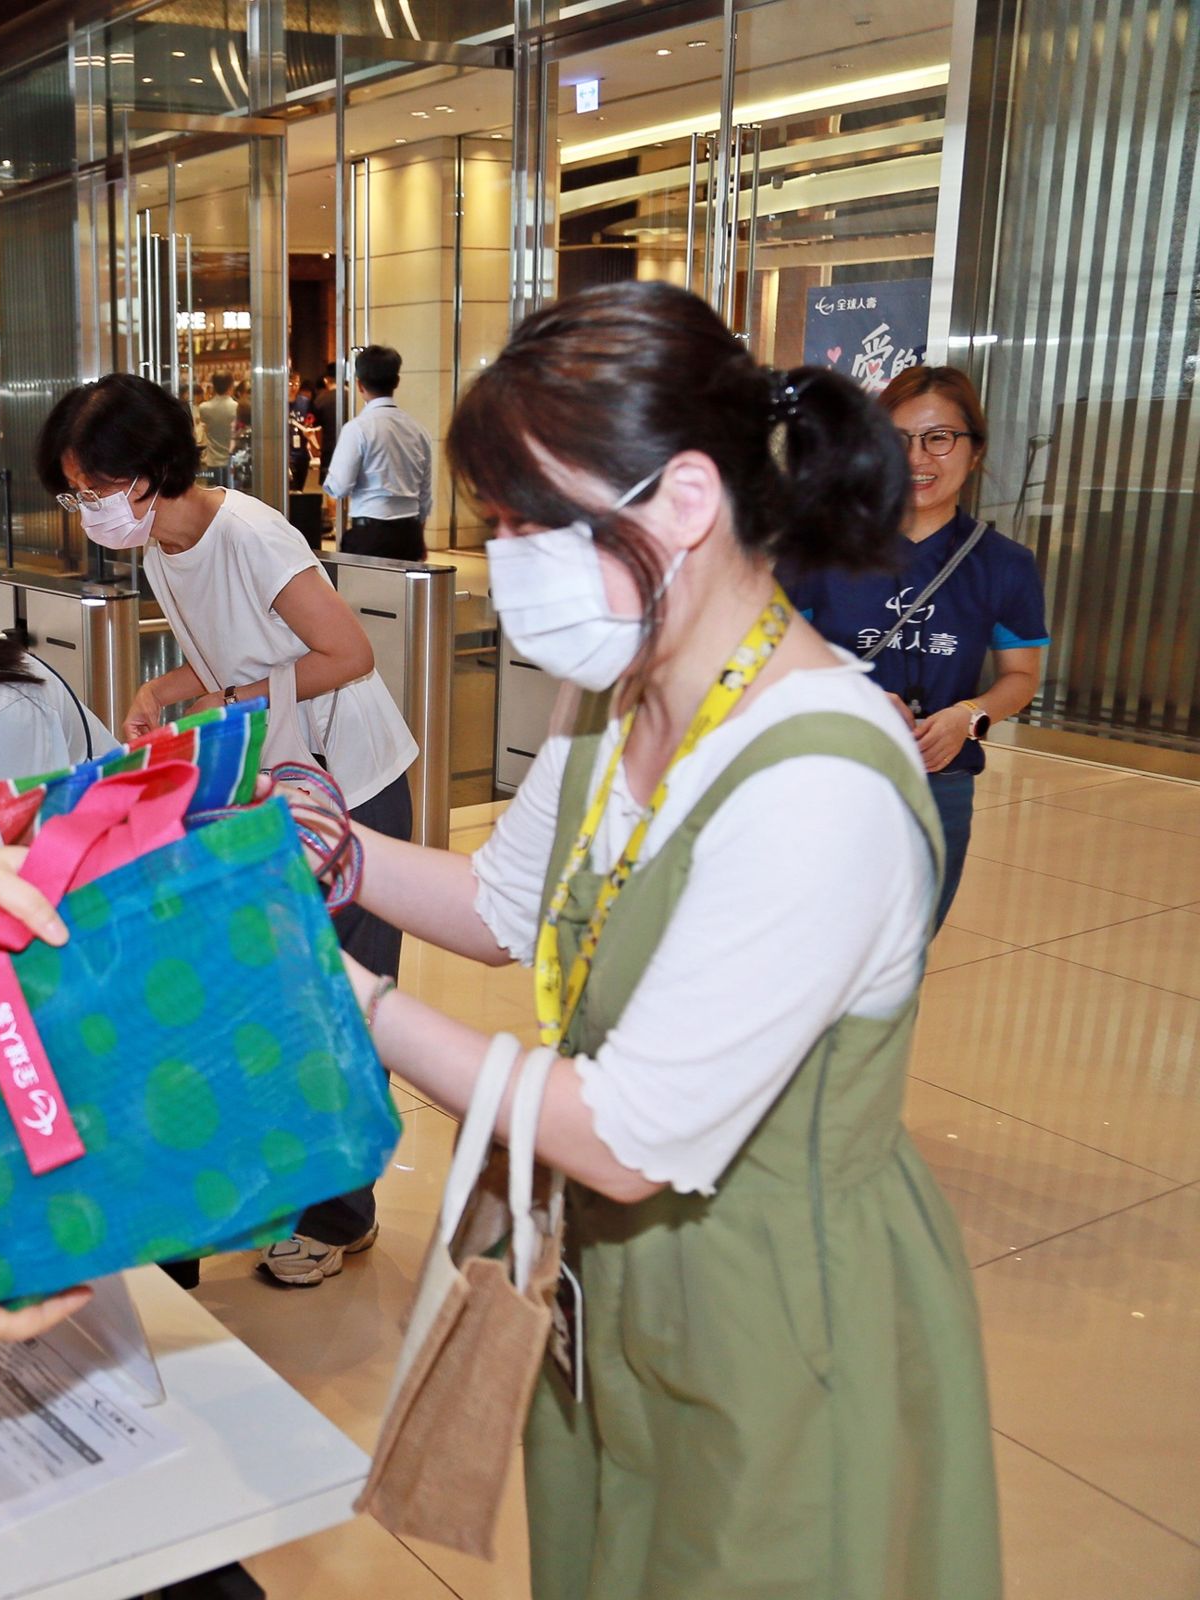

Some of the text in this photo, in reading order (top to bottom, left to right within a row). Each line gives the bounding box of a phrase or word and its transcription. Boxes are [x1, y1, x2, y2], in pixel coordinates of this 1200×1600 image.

[837, 297, 877, 311] 全球人壽
[851, 322, 928, 391] 愛的
